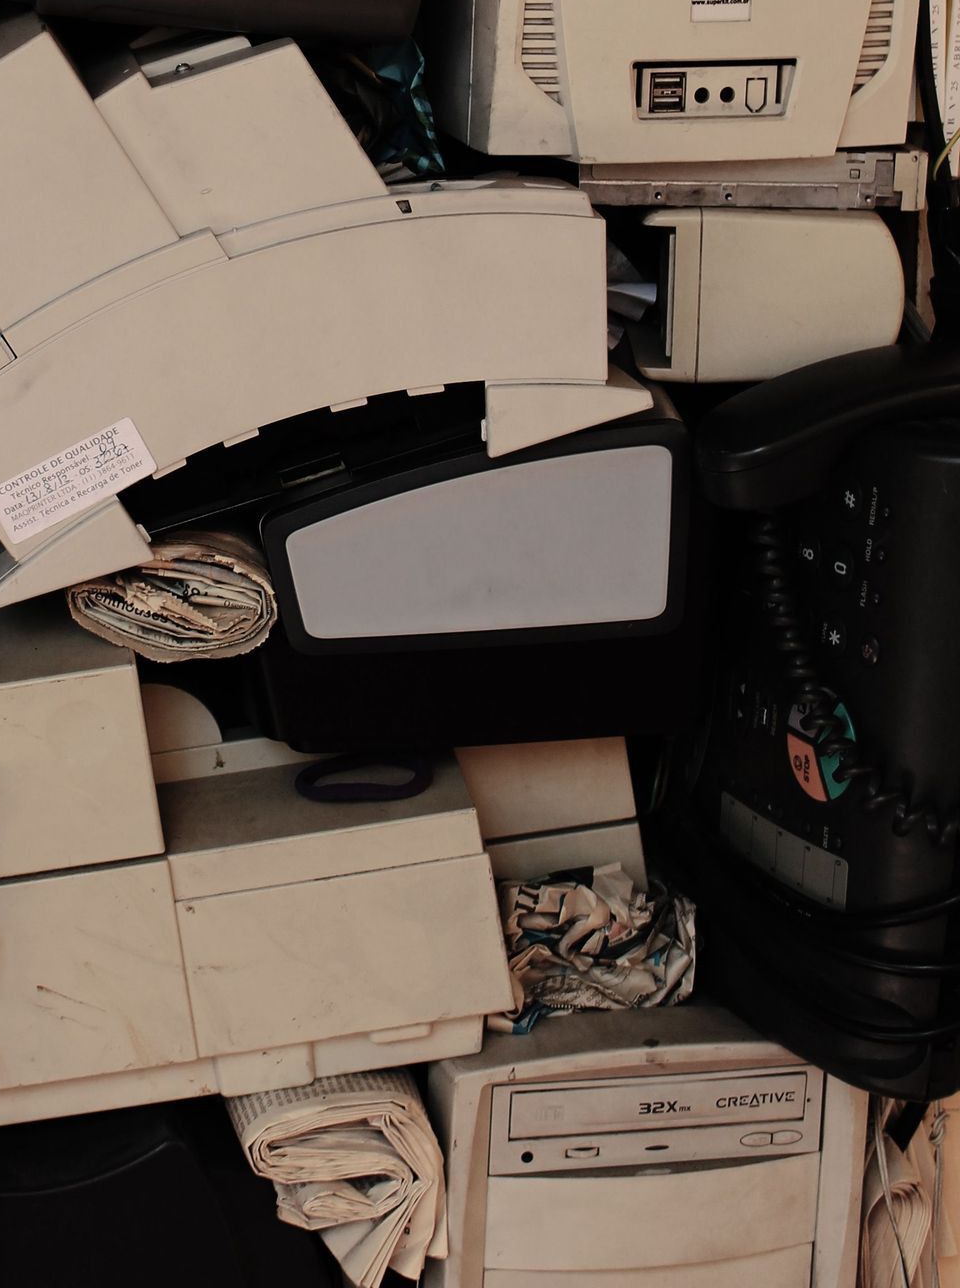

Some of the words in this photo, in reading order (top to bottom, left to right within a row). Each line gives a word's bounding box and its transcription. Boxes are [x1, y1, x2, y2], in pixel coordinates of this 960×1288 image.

[50, 456, 64, 468] DE
[64, 426, 121, 461] QUALIDADE
[76, 477, 109, 499] Recarga
[108, 471, 120, 481] de
[120, 458, 144, 475] Toner
[802, 548, 814, 561] 8
[865, 537, 873, 562] HOLD
[715, 1090, 796, 1110] CREATIVE
